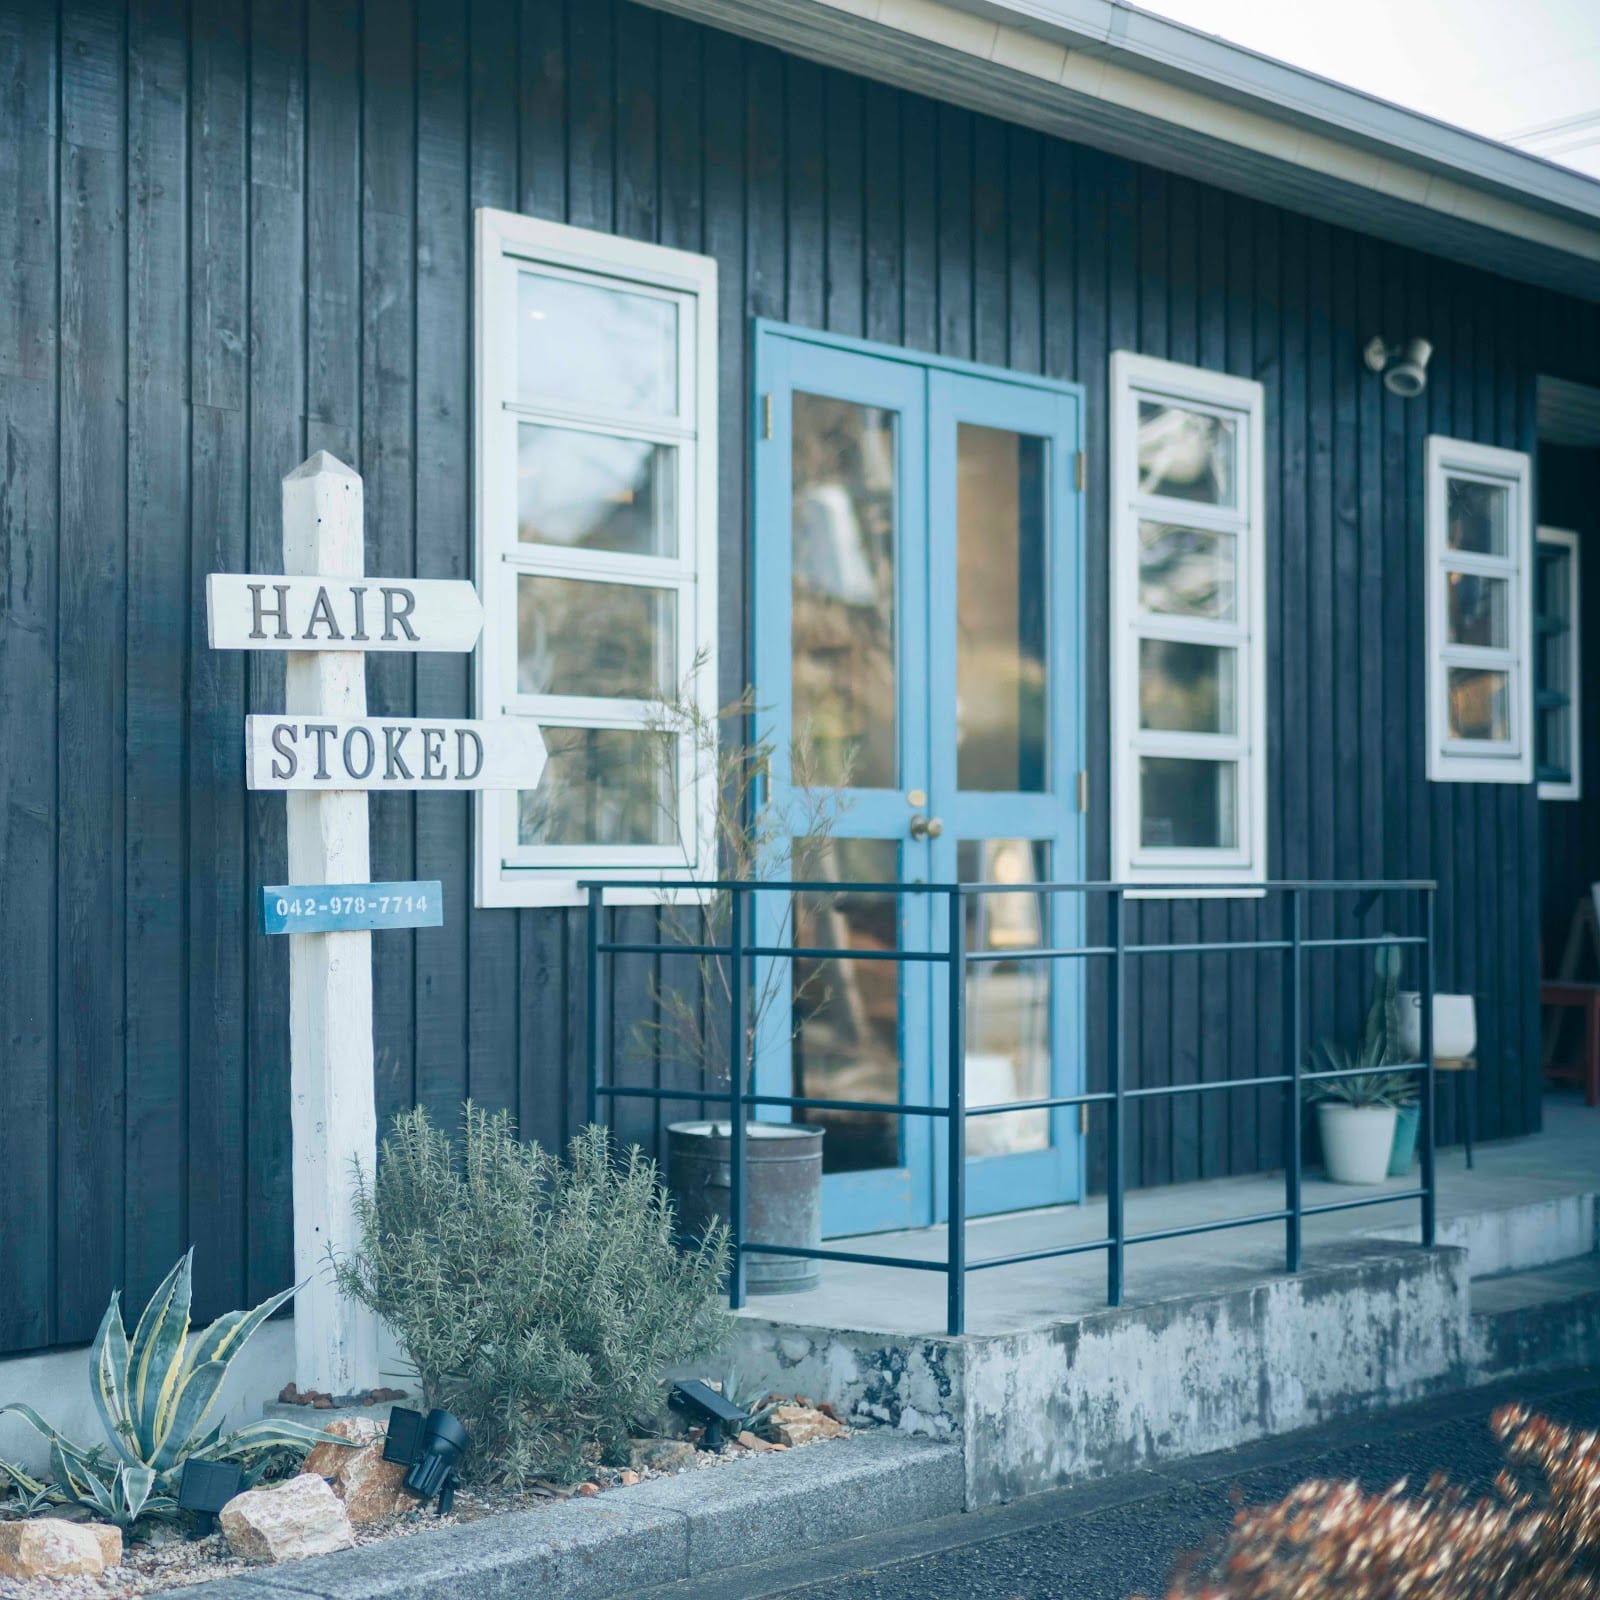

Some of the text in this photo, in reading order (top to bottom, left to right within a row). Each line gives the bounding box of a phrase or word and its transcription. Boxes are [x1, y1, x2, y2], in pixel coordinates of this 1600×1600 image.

[247, 584, 421, 642] HAIR
[271, 723, 484, 781] STOKED
[276, 895, 428, 916] 042-978-7714
